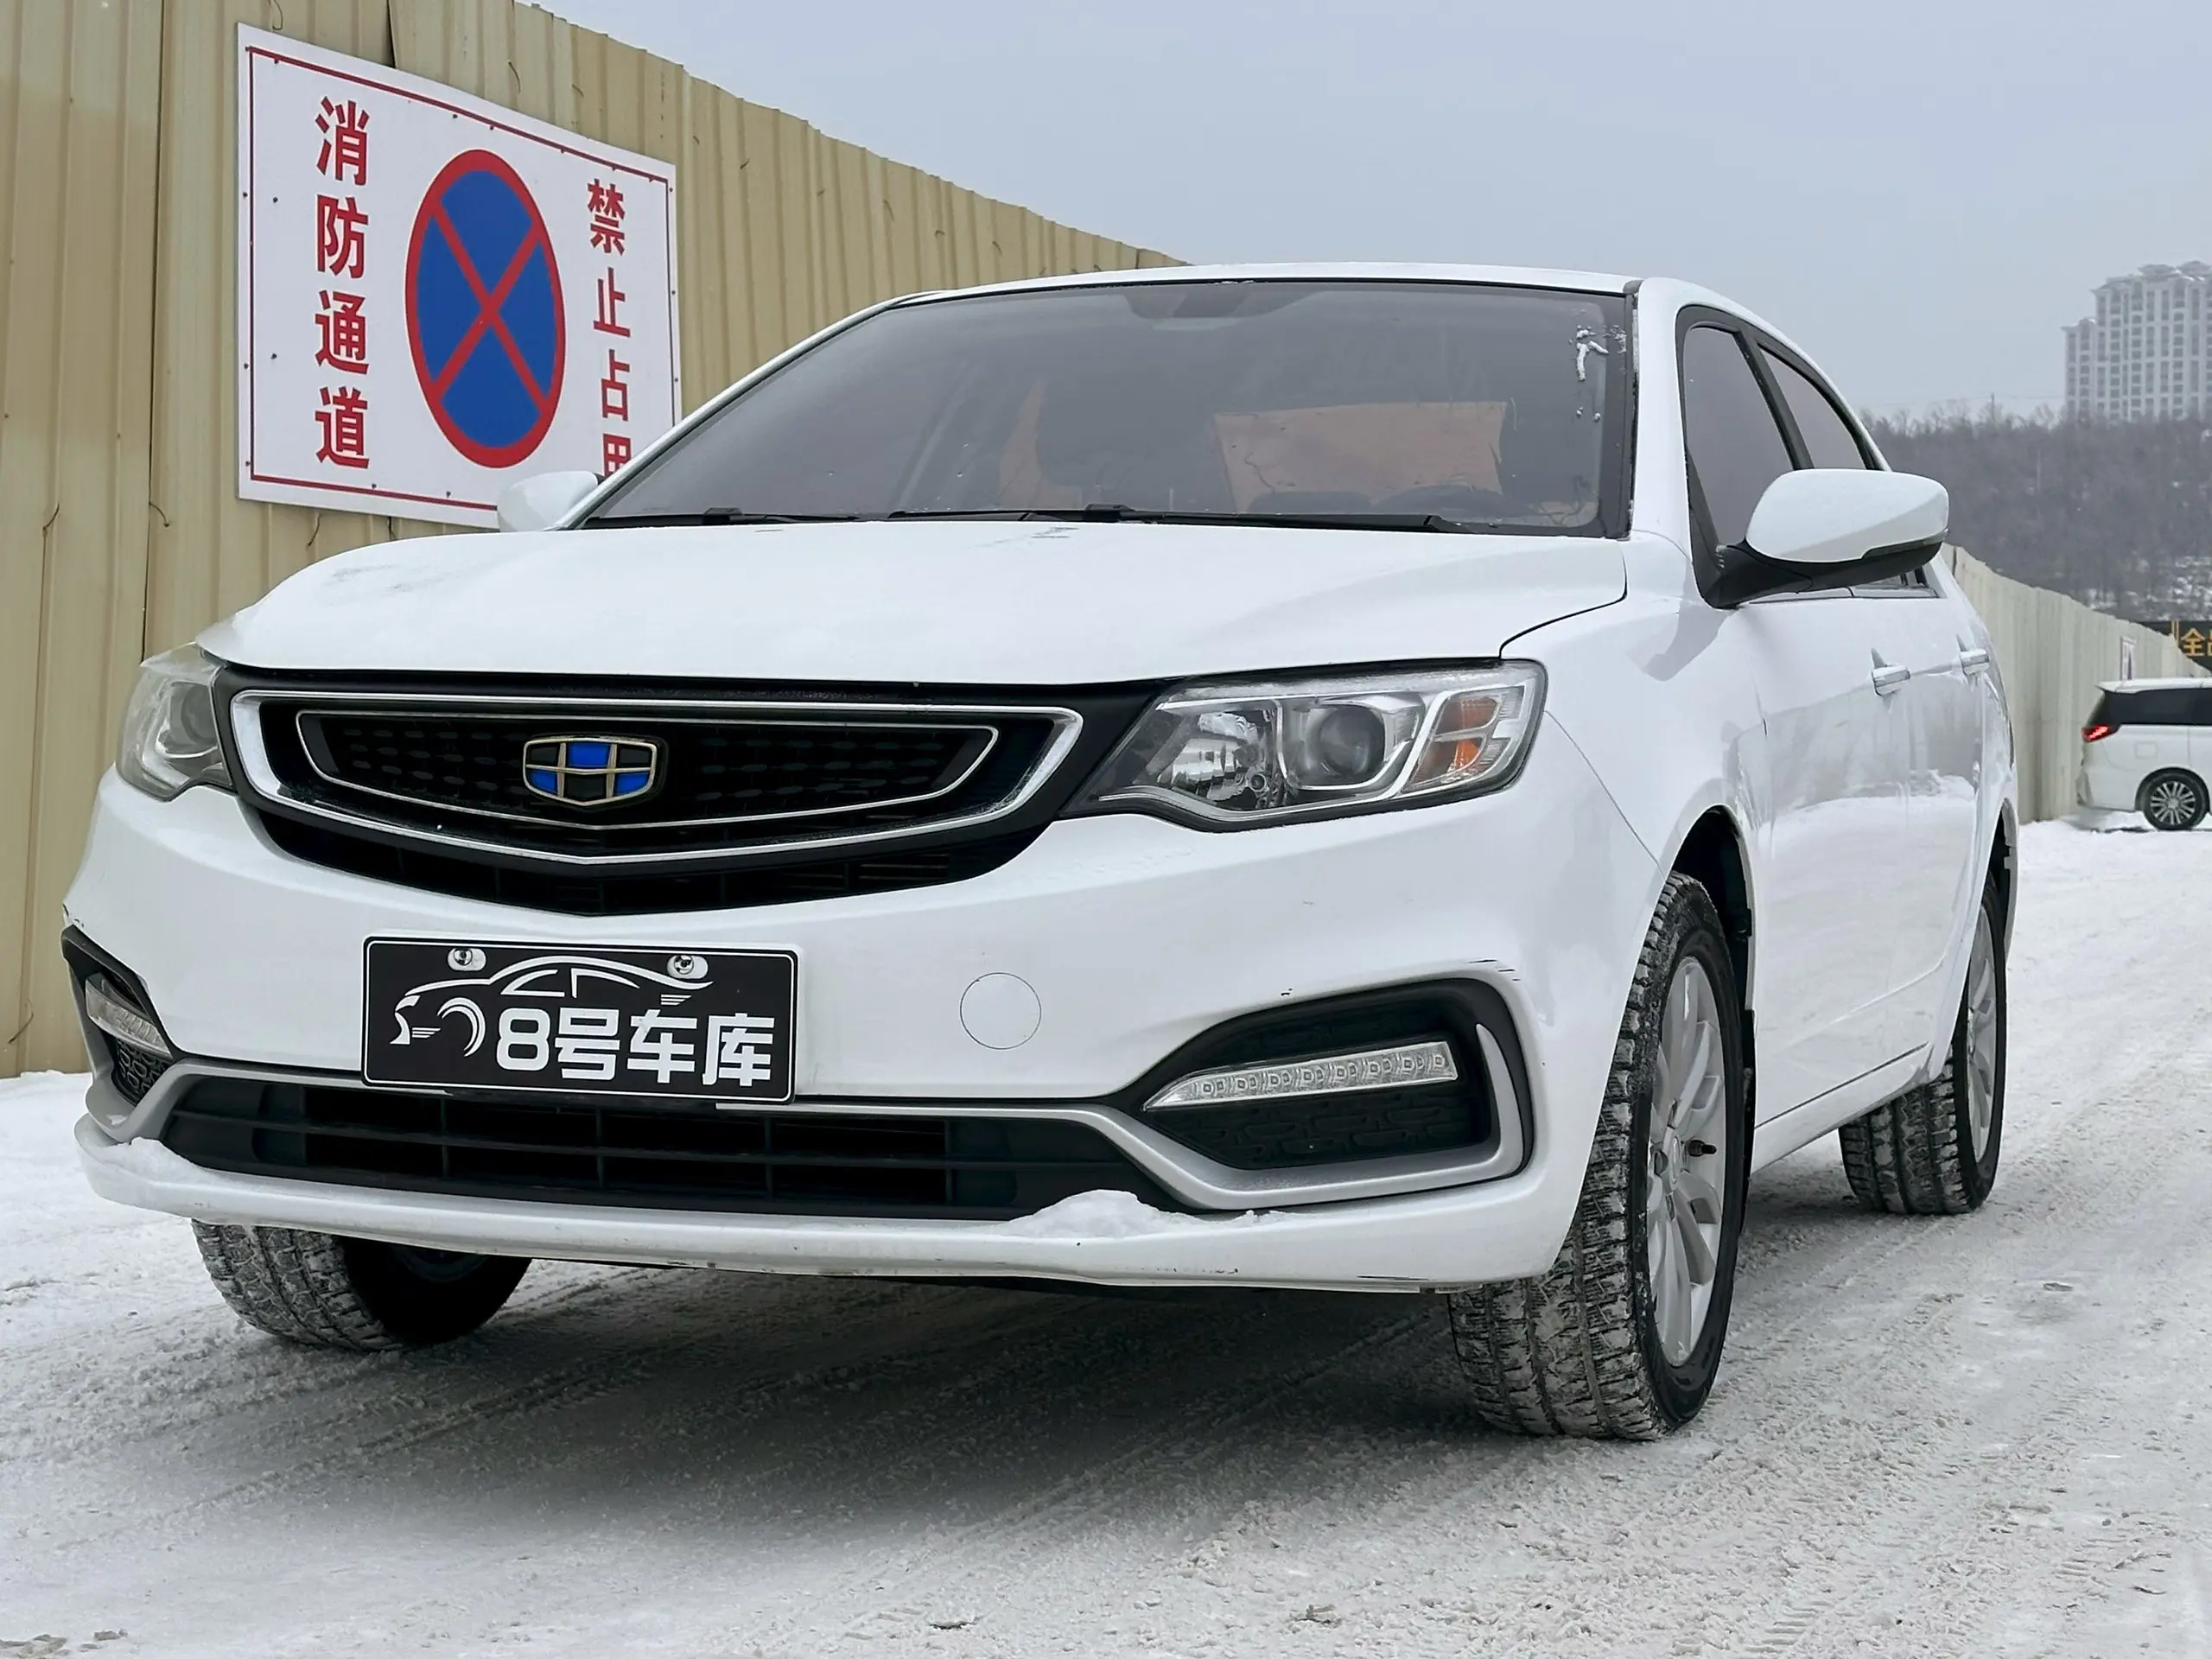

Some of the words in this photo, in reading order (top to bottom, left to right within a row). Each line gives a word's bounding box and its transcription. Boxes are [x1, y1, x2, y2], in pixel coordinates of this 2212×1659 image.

[315, 96, 369, 468] 消防通道
[2180, 627, 2212, 657] 全
[496, 1007, 775, 1087] 8号车库
